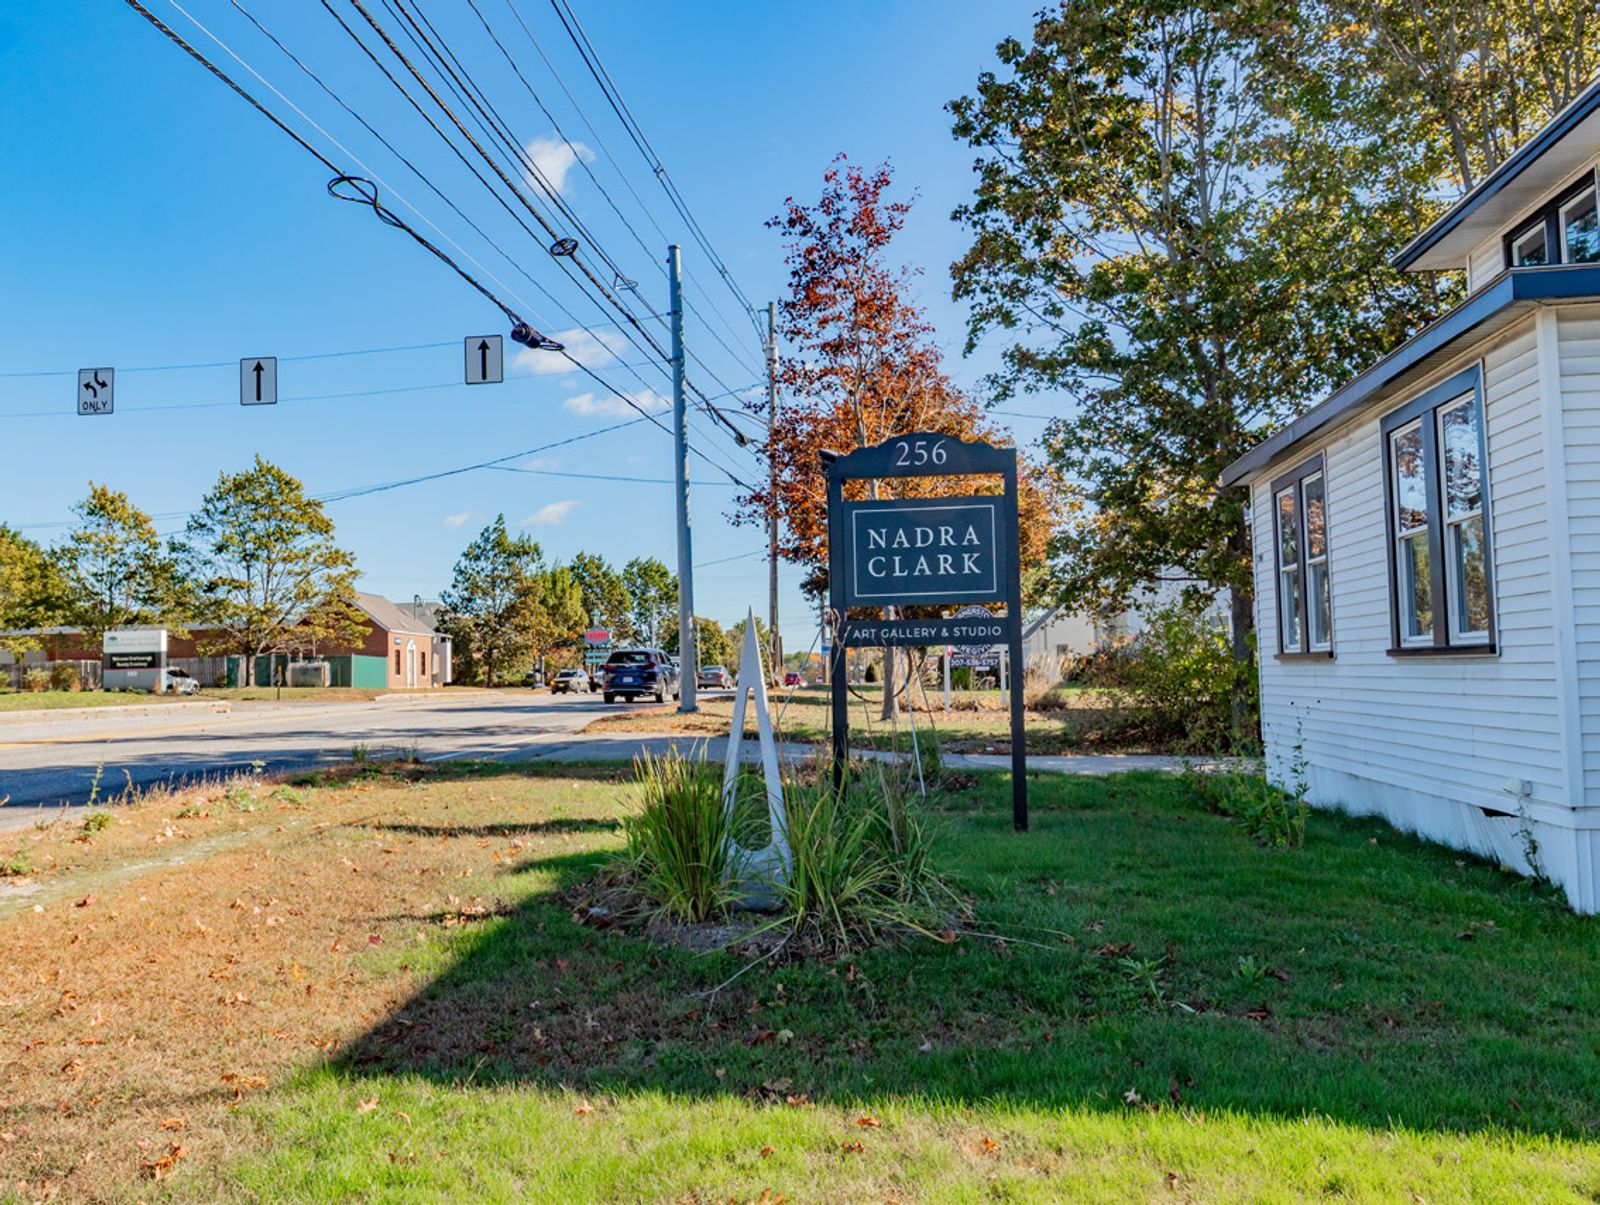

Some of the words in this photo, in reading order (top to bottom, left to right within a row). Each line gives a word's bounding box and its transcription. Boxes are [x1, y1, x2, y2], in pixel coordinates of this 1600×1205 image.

[82, 400, 108, 411] ONLY
[895, 439, 947, 466] 256
[867, 525, 981, 549] NADRA
[867, 552, 982, 577] CLARK
[852, 628, 876, 639] ART
[880, 626, 937, 639] GALLERY
[941, 627, 949, 637] &
[953, 626, 1001, 636] STUDIO
